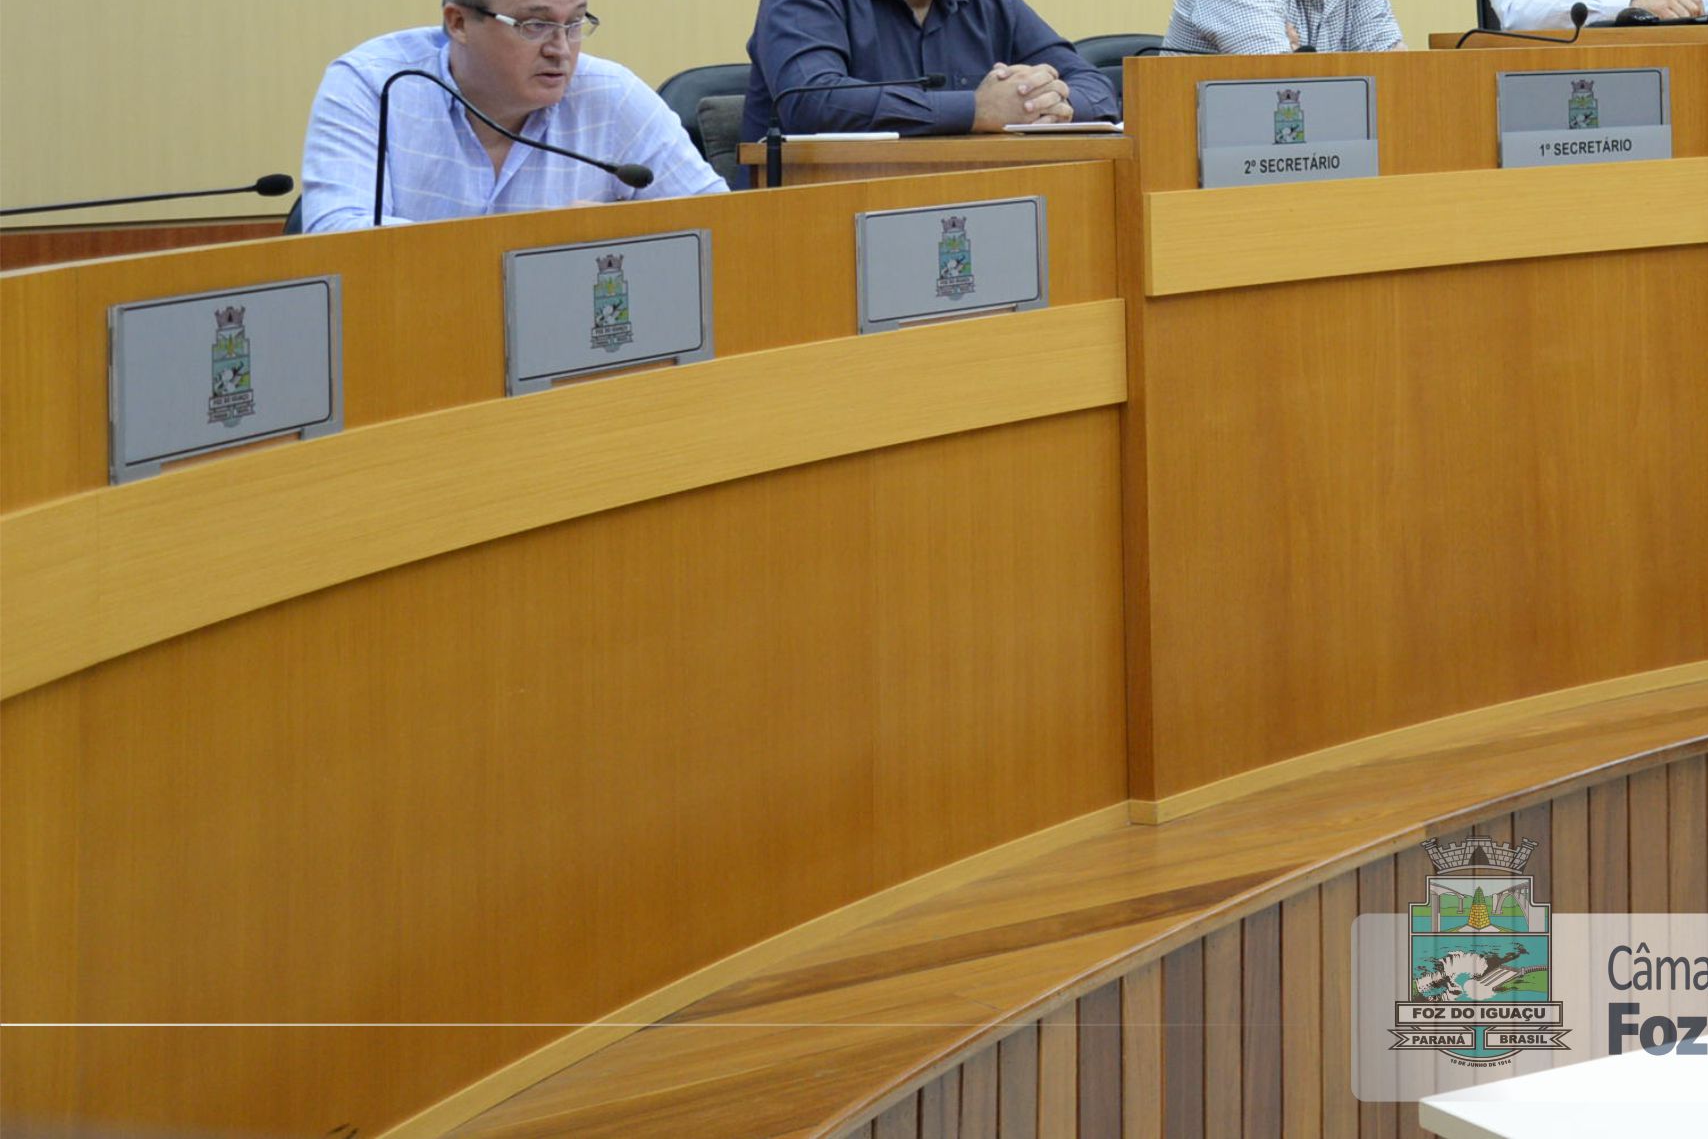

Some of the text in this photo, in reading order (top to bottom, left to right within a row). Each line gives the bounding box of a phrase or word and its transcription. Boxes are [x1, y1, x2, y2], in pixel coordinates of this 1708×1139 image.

[1553, 136, 1632, 156] SECRETÁRIO
[1244, 152, 1341, 174] 2º SECRETÁRIO
